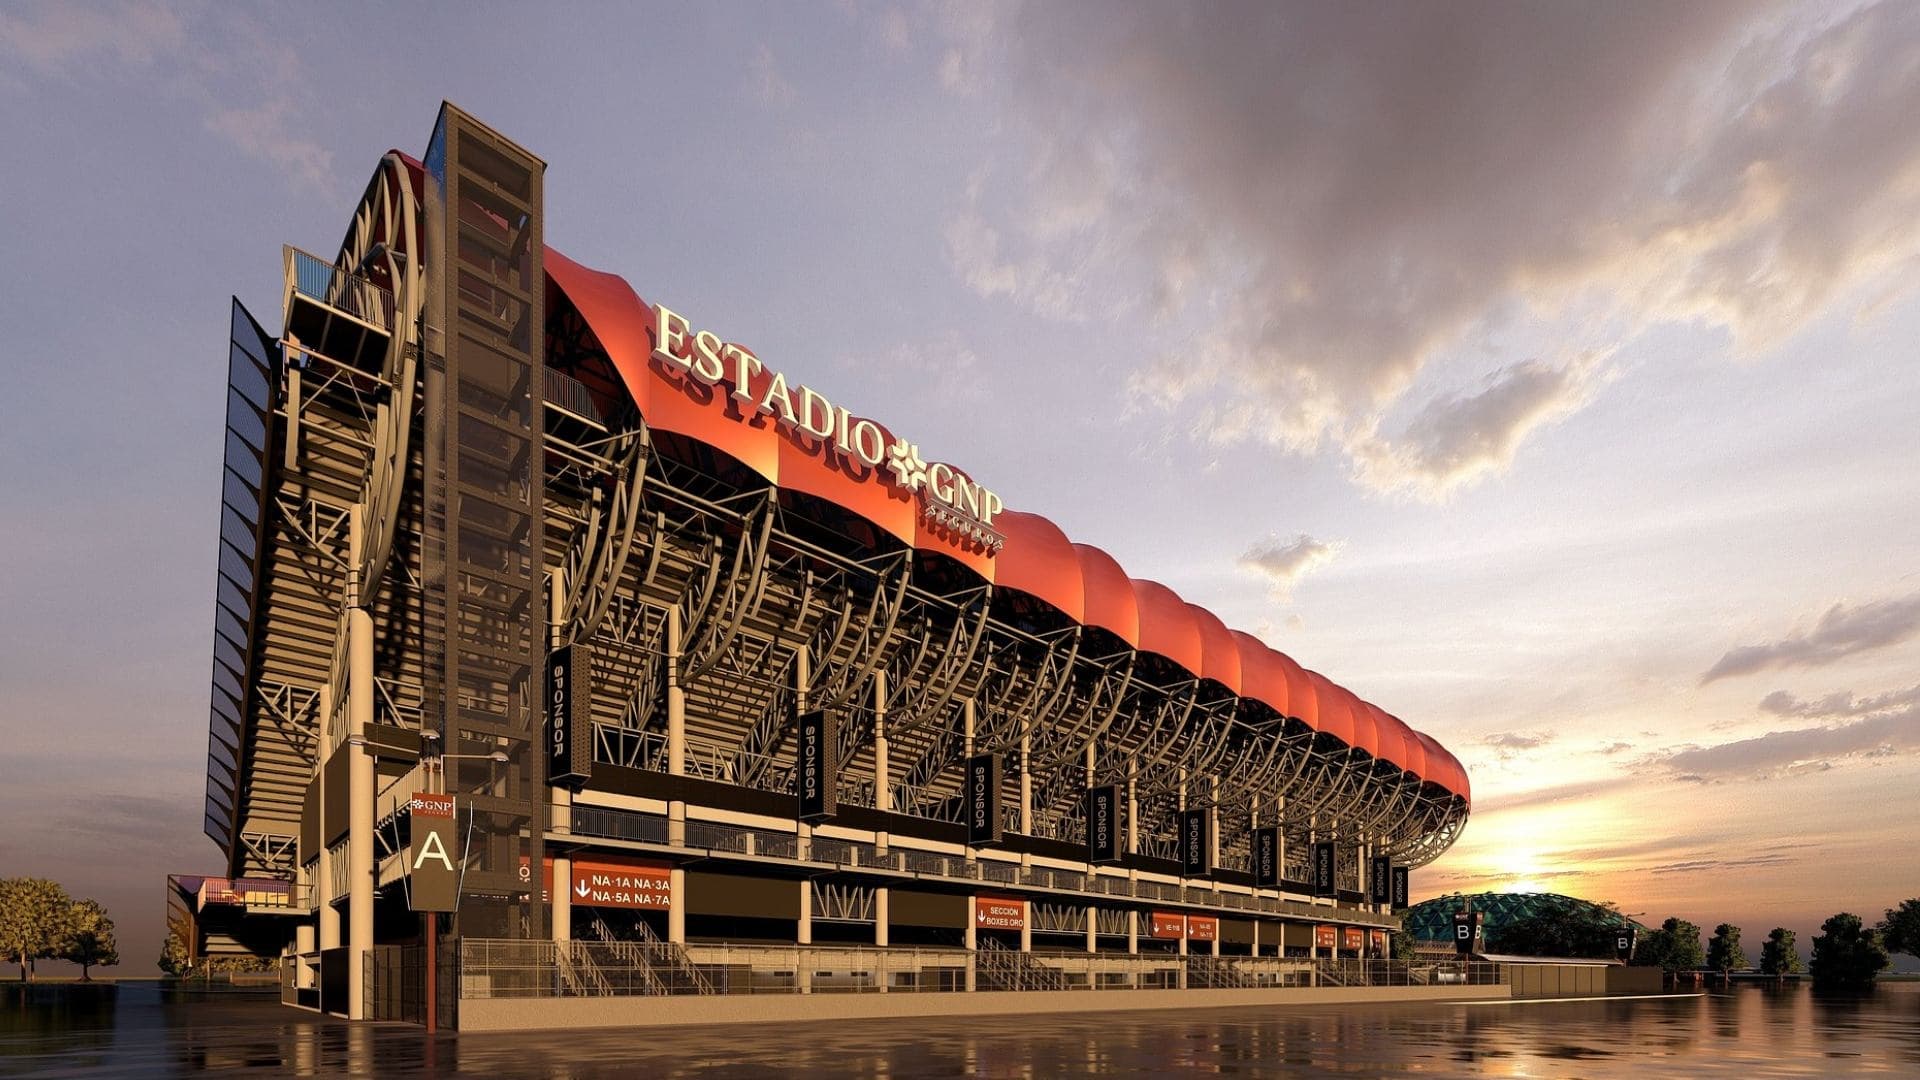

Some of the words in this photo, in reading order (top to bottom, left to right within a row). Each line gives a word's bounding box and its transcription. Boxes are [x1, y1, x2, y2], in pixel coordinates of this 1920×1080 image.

[651, 303, 885, 468] ESTADIO
[925, 462, 1003, 527] GNP
[554, 665, 563, 758] SPONSOR
[805, 726, 815, 800] SPONSOR
[424, 800, 452, 811] GNP
[975, 766, 985, 829] SPONSOR
[1098, 796, 1107, 849] SPONSOR
[1190, 817, 1198, 865] SPONSOR
[413, 831, 454, 871] A
[1262, 835, 1270, 878] SPONSOR
[1457, 925, 1470, 939] B
[1617, 937, 1628, 949] B
